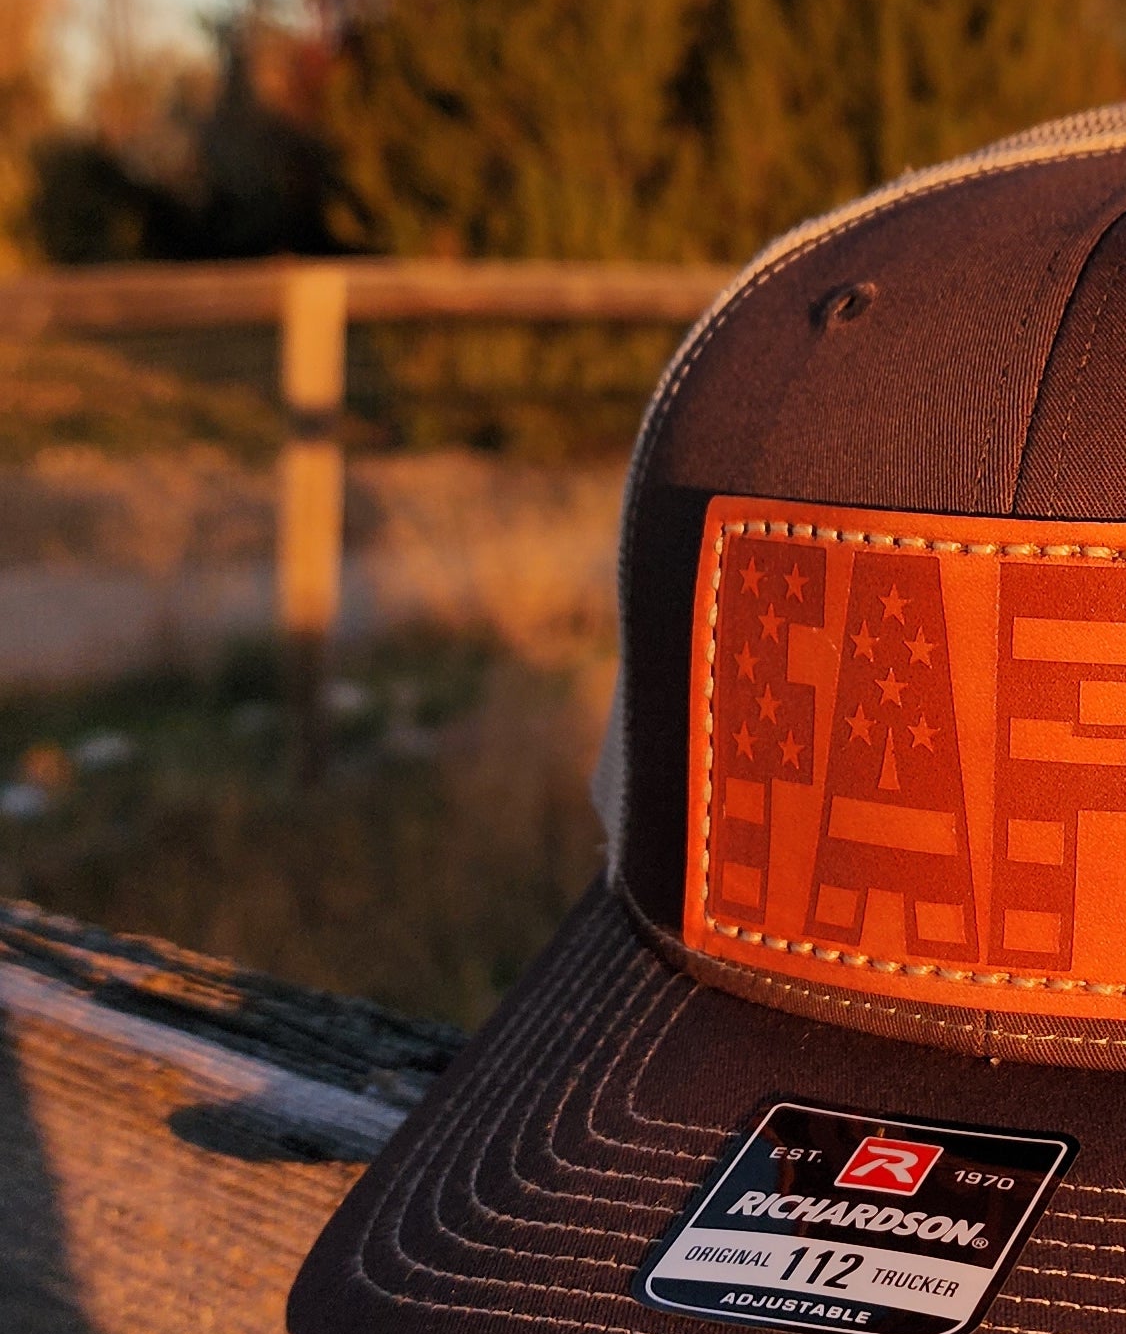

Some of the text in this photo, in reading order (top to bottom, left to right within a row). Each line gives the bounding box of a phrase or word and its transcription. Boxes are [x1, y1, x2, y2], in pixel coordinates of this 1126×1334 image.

[769, 1146, 823, 1164] EST.
[954, 1169, 1015, 1190] 1970
[684, 1244, 960, 1298] ORIGINAL 112 TRUCKER
[719, 1291, 872, 1324] ADJUSTABLE
